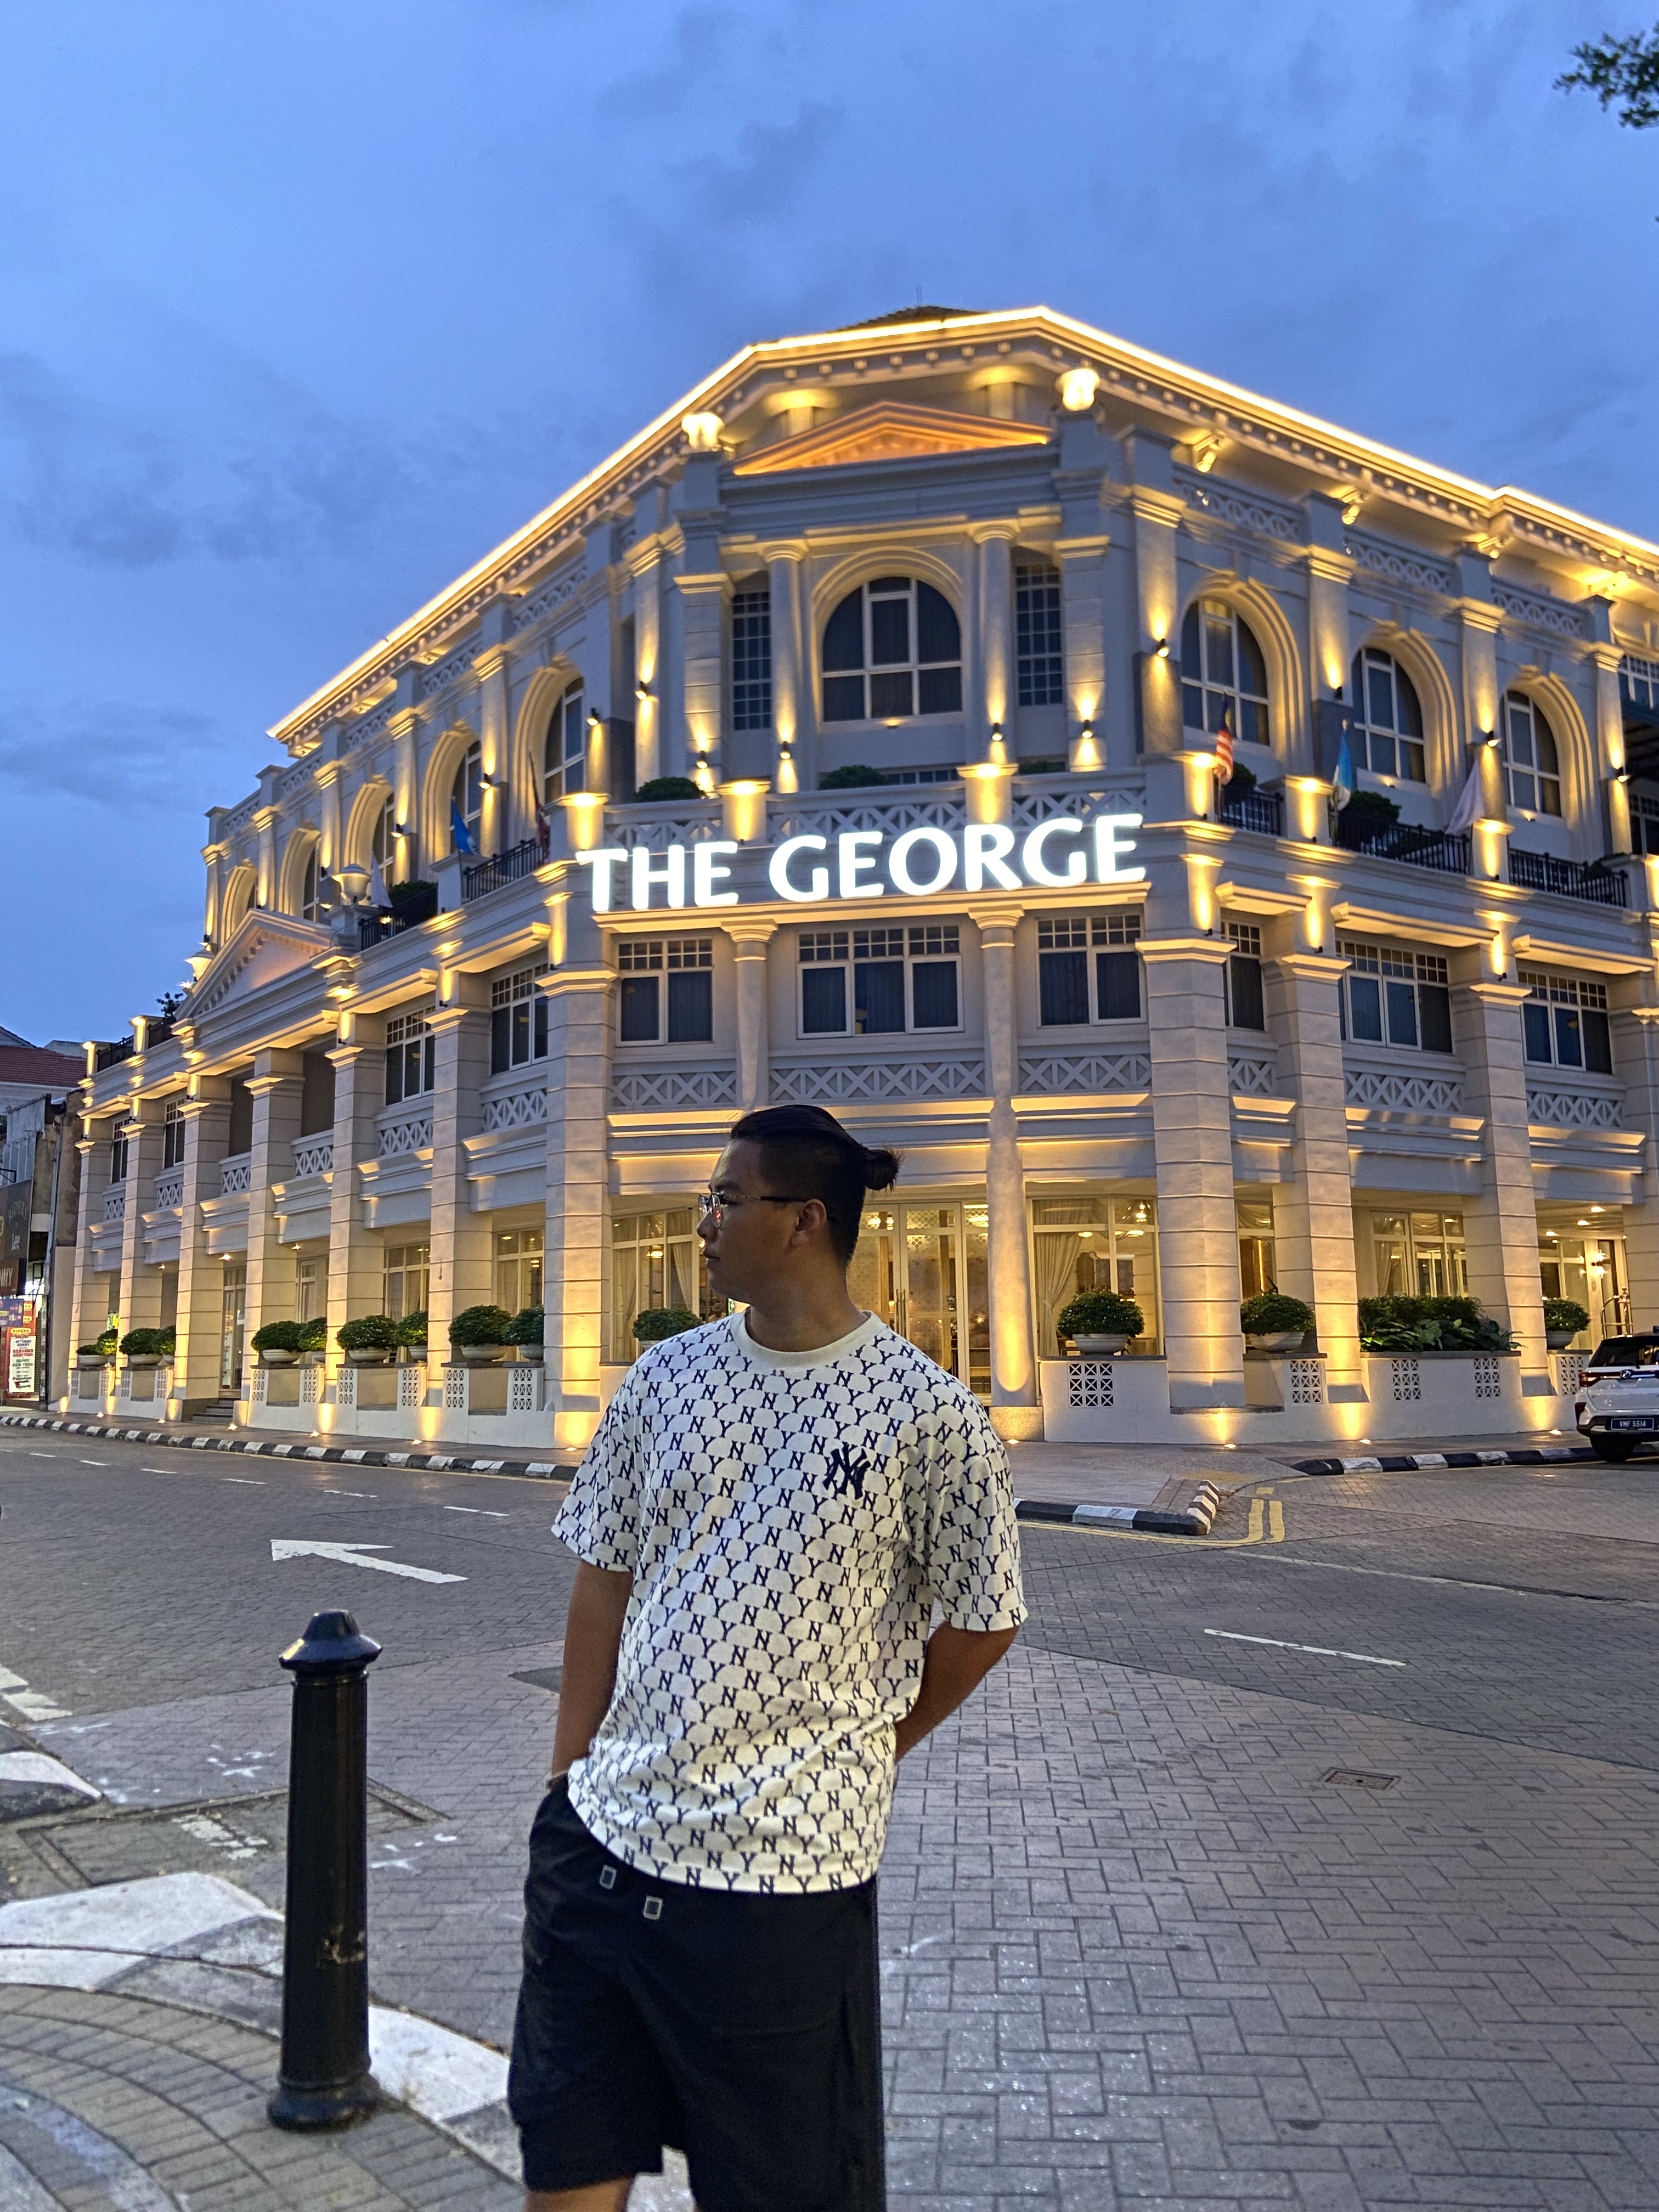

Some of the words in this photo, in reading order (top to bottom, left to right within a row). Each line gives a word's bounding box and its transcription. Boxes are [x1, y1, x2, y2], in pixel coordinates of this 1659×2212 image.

[575, 840, 738, 912] THE
[769, 813, 1146, 902] GEORGE
[12, 1233, 20, 1250] Lee
[859, 1359, 877, 1376] Y
[887, 1367, 908, 1385] N
[924, 1375, 941, 1393] Y
[784, 1377, 801, 1395] Y
[810, 1381, 831, 1401] N
[847, 1388, 865, 1407] Y
[873, 1396, 895, 1416] N
[909, 1404, 928, 1426] Y
[833, 1369, 854, 1388] N
[866, 1376, 885, 1395] Y
[897, 1385, 919, 1405] N
[930, 1395, 949, 1416] Y
[950, 1392, 967, 1415] N
[712, 1401, 729, 1419] Y
[737, 1406, 757, 1425] N
[773, 1410, 789, 1430] Y
[798, 1415, 819, 1435] N
[833, 1420, 851, 1440] Y
[860, 1428, 882, 1451] N
[894, 1438, 911, 1459] Y
[759, 1391, 779, 1410] N
[791, 1395, 808, 1414] Y
[820, 1401, 842, 1420] N
[853, 1407, 871, 1426] Y
[883, 1417, 904, 1438] N
[913, 1427, 932, 1449] Y
[933, 1420, 955, 1446] N
[956, 1417, 975, 1442] N
[719, 1419, 736, 1438] Y
[749, 1425, 769, 1447] N
[781, 1430, 797, 1450] Y
[808, 1435, 828, 1456] N
[700, 1434, 716, 1454] Y
[726, 1440, 747, 1462] N
[763, 1446, 779, 1466] Y
[787, 1450, 806, 1471] N
[933, 1448, 956, 1472] N
[960, 1442, 980, 1466] Y
[676, 1451, 695, 1471] N
[708, 1454, 725, 1475] Y
[739, 1462, 759, 1483] N
[769, 1466, 785, 1486] Y
[797, 1471, 818, 1494] N
[870, 1452, 891, 1475] N
[896, 1460, 913, 1481] Y
[572, 1476, 587, 1496] Y
[933, 1473, 953, 1496] Y
[949, 1486, 967, 1510] N
[967, 1498, 984, 1521] Y
[974, 1476, 990, 1498] Y
[690, 1471, 707, 1493] Y
[717, 1477, 737, 1499] N
[751, 1483, 768, 1503] Y
[775, 1487, 795, 1509] N
[811, 1493, 829, 1516] Y
[838, 1504, 858, 1527] N
[869, 1511, 885, 1533] Y
[860, 1489, 879, 1513] N
[619, 1515, 639, 1535] N
[700, 1492, 715, 1514] Y
[728, 1499, 747, 1521] N
[757, 1503, 773, 1525] Y
[786, 1509, 806, 1533] N
[819, 1517, 837, 1541] Y
[599, 1526, 618, 1547] N
[687, 1530, 704, 1551] Y
[706, 1515, 726, 1537] N
[737, 1520, 755, 1541] Y
[763, 1525, 783, 1549] N
[799, 1533, 817, 1556] Y
[826, 1542, 848, 1567] N
[854, 1548, 870, 1568] Y
[692, 1553, 712, 1573] N
[744, 1541, 760, 1562] Y
[774, 1549, 794, 1572] N
[808, 1556, 825, 1578] Y
[985, 1554, 1000, 1576] Y
[675, 1567, 691, 1589] Y
[699, 1573, 720, 1596] N
[732, 1579, 748, 1602] Y
[763, 1588, 783, 1613] N
[797, 1596, 813, 1618] Y
[826, 1604, 845, 1626] N
[751, 1564, 771, 1588] N
[788, 1572, 806, 1595] Y
[815, 1581, 836, 1604] N
[658, 1585, 674, 1606] Y
[679, 1590, 697, 1612] N
[712, 1596, 730, 1619] Y
[740, 1604, 760, 1628] N
[778, 1612, 796, 1635] Y
[806, 1620, 823, 1643] N
[987, 1592, 1005, 1613] Y
[687, 1613, 707, 1637] N
[720, 1620, 737, 1643] Y
[752, 1628, 773, 1652] N
[787, 1636, 804, 1659] Y
[667, 1629, 685, 1652] N
[701, 1636, 718, 1659] Y
[729, 1644, 749, 1668] N
[768, 1652, 785, 1675] Y
[795, 1661, 814, 1681] N
[651, 1645, 665, 1667] Y
[677, 1653, 696, 1677] N
[709, 1660, 726, 1683] Y
[742, 1668, 762, 1692] N
[776, 1675, 794, 1697] Y
[657, 1669, 674, 1693] N
[690, 1677, 707, 1700] Y
[719, 1685, 739, 1709] N
[758, 1692, 775, 1714] Y
[887, 1677, 903, 1698] Y
[669, 1694, 685, 1718] N
[699, 1701, 716, 1724] Y
[732, 1708, 753, 1731] N
[681, 1718, 697, 1741] Y
[689, 1741, 706, 1764] Y
[753, 1743, 770, 1765] Y
[670, 1756, 687, 1780] Y
[861, 1764, 876, 1785] Y
[669, 1782, 686, 1806] Y
[750, 1777, 765, 1797] Y
[805, 1771, 822, 1792] Y
[656, 1820, 674, 1842] Y
[710, 1812, 727, 1833] N
[743, 1817, 760, 1837] Y
[810, 1812, 826, 1834] Y
[668, 1843, 686, 1863] Y
[725, 1834, 744, 1852] Y
[740, 1851, 757, 1874] Y
[811, 1854, 828, 1876] Y
